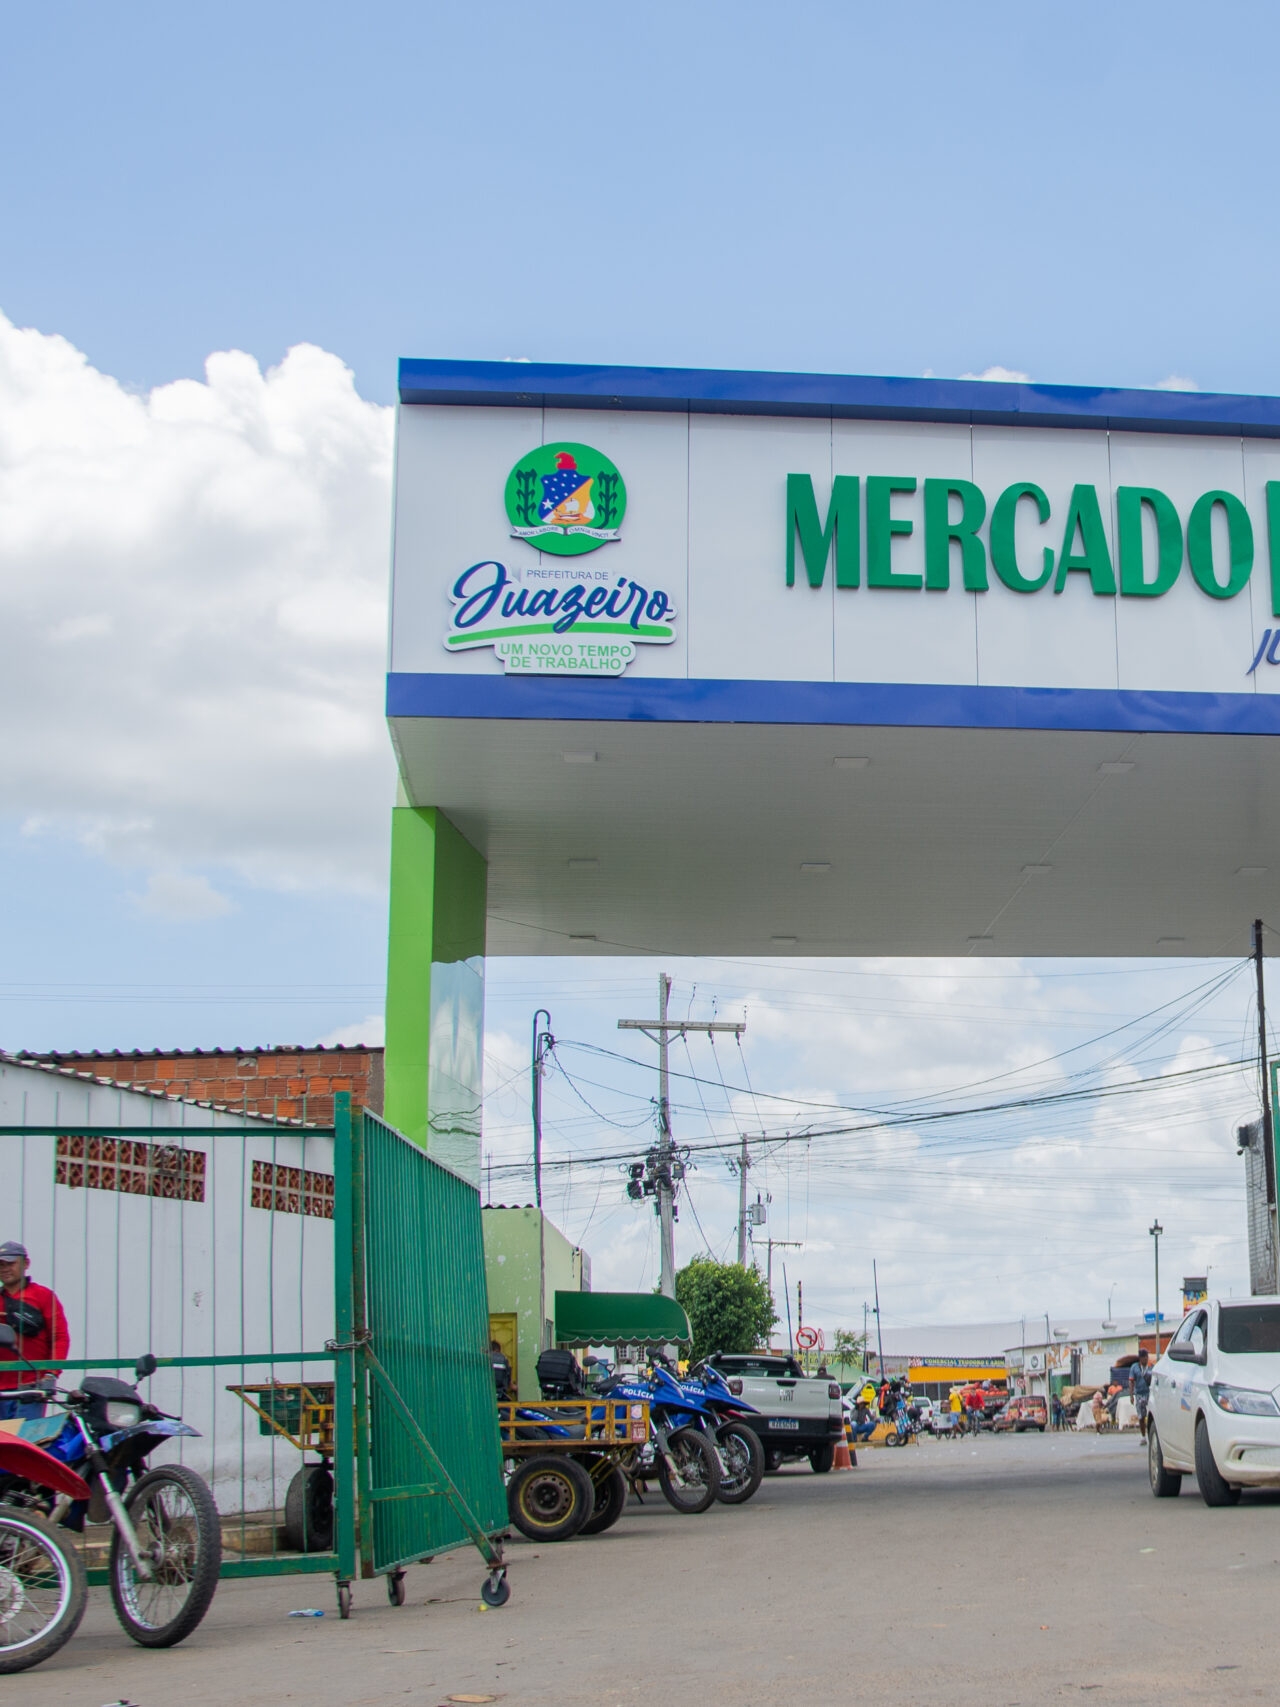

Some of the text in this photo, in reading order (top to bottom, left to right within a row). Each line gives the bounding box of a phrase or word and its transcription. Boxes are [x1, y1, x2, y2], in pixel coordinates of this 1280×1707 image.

[786, 473, 1254, 599] MERCADO
[526, 569, 609, 580] PREFEITURA DE
[452, 560, 674, 635] Juazeiro
[499, 643, 632, 658] UM NOVO TEMPO
[510, 655, 622, 671] DE TRABALHO
[623, 1387, 655, 1401] POLÍCIA
